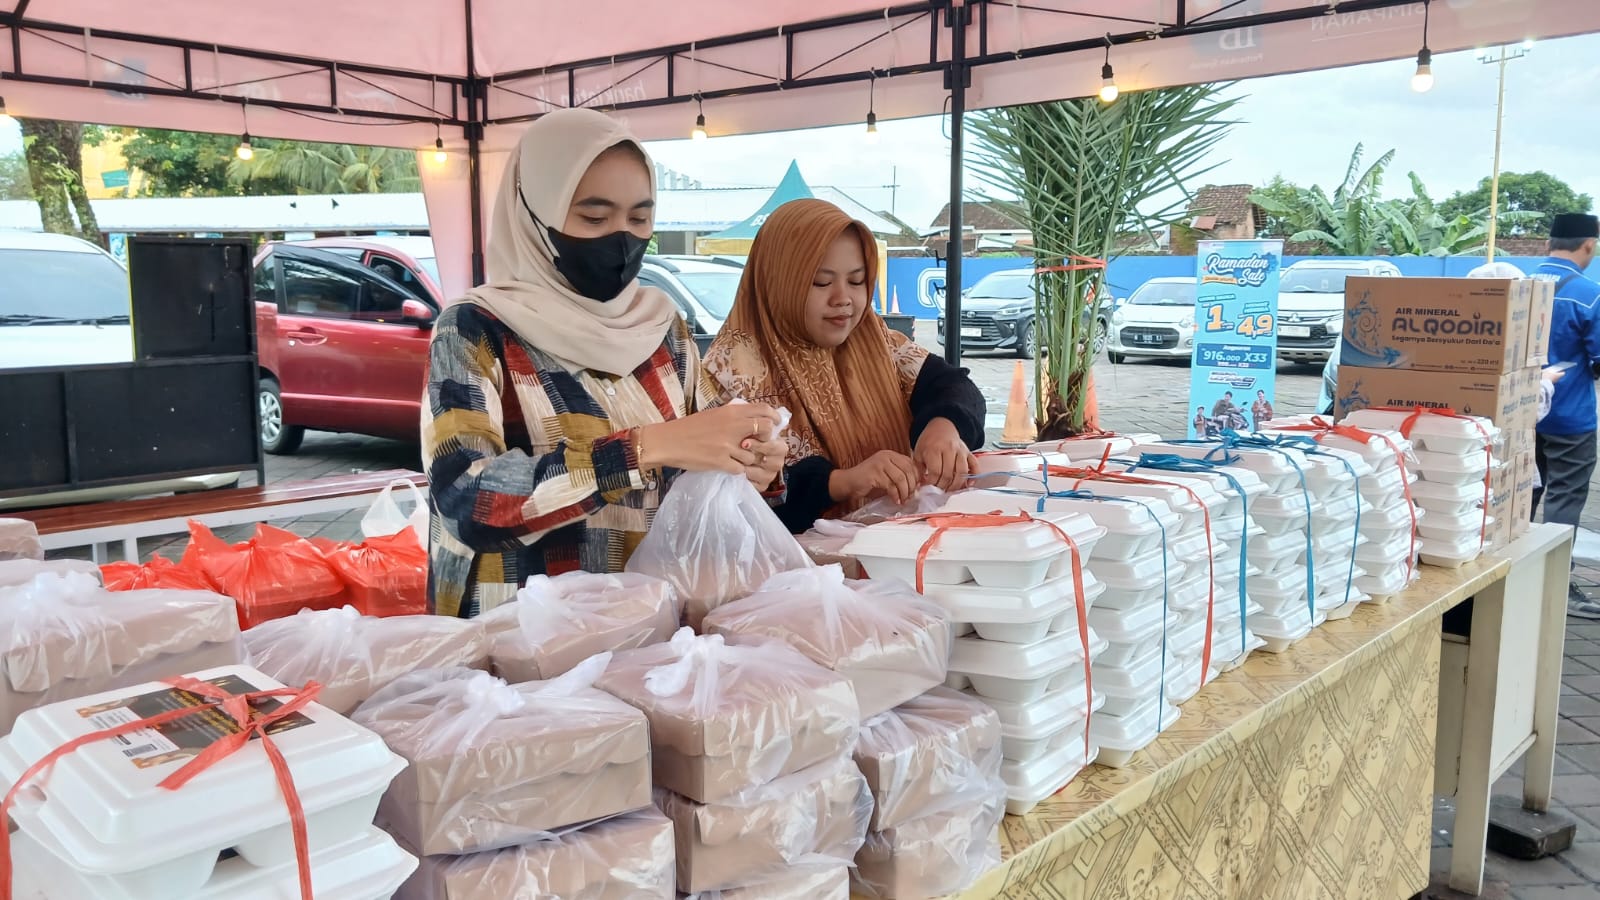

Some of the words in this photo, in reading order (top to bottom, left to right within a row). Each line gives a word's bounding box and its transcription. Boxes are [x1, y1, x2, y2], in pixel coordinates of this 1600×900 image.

[1206, 253, 1269, 275] Ramadan
[1238, 268, 1265, 287] Sale
[1206, 304, 1224, 331] 1
[1395, 307, 1412, 315] AIR
[1415, 308, 1461, 316] MINERAL
[1391, 335, 1426, 343] Segarnya
[1426, 336, 1464, 345] Bersyukur
[1203, 350, 1241, 361] 916.000
[1243, 352, 1268, 363] X33
[1387, 399, 1403, 407] AIR
